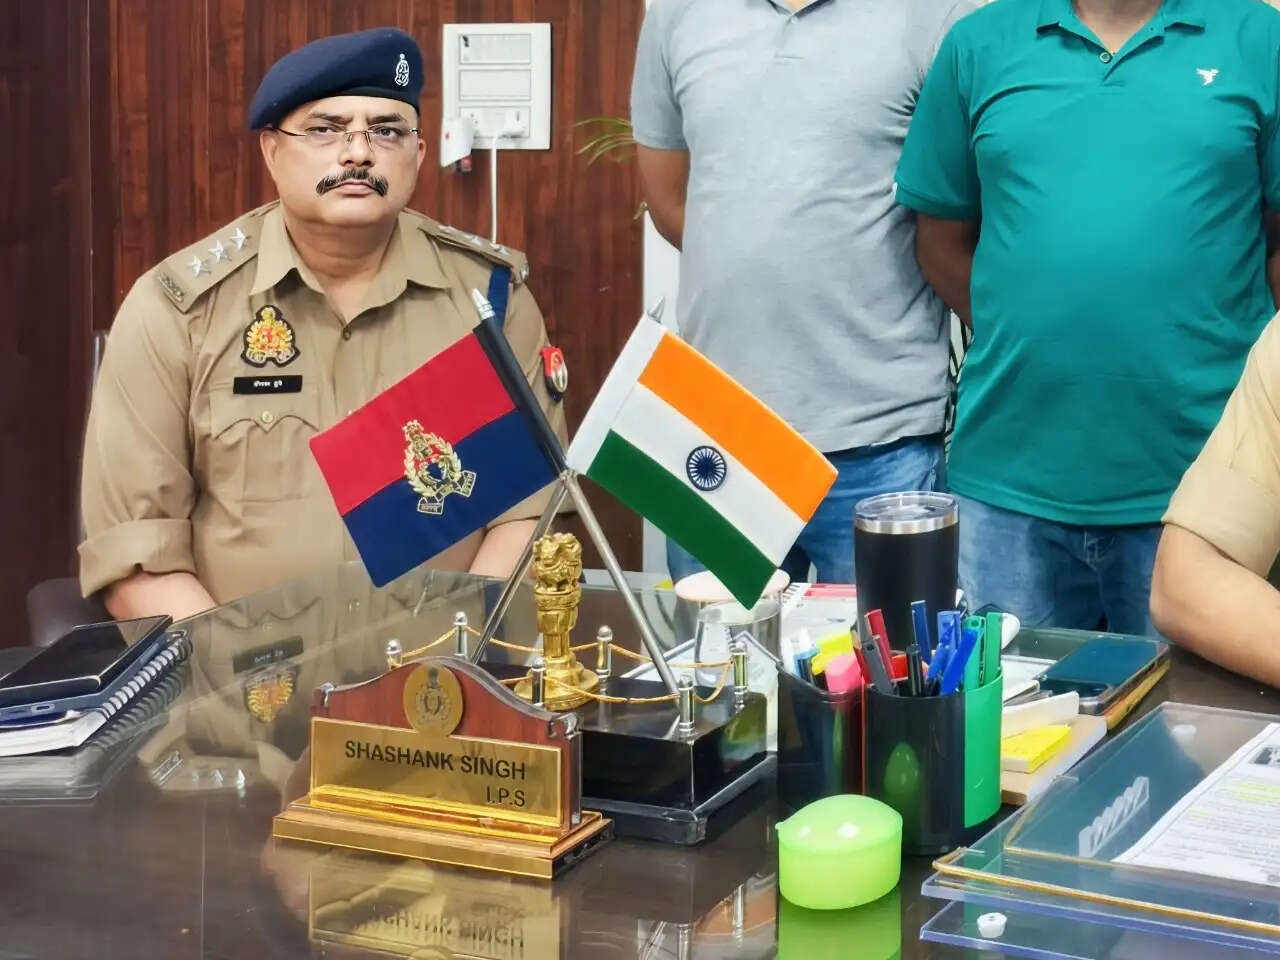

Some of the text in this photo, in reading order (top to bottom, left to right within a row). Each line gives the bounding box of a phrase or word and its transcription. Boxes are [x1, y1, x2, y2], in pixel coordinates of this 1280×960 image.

[345, 740, 526, 780] SHASHANK SINGH
[486, 786, 526, 808] I.P.S
